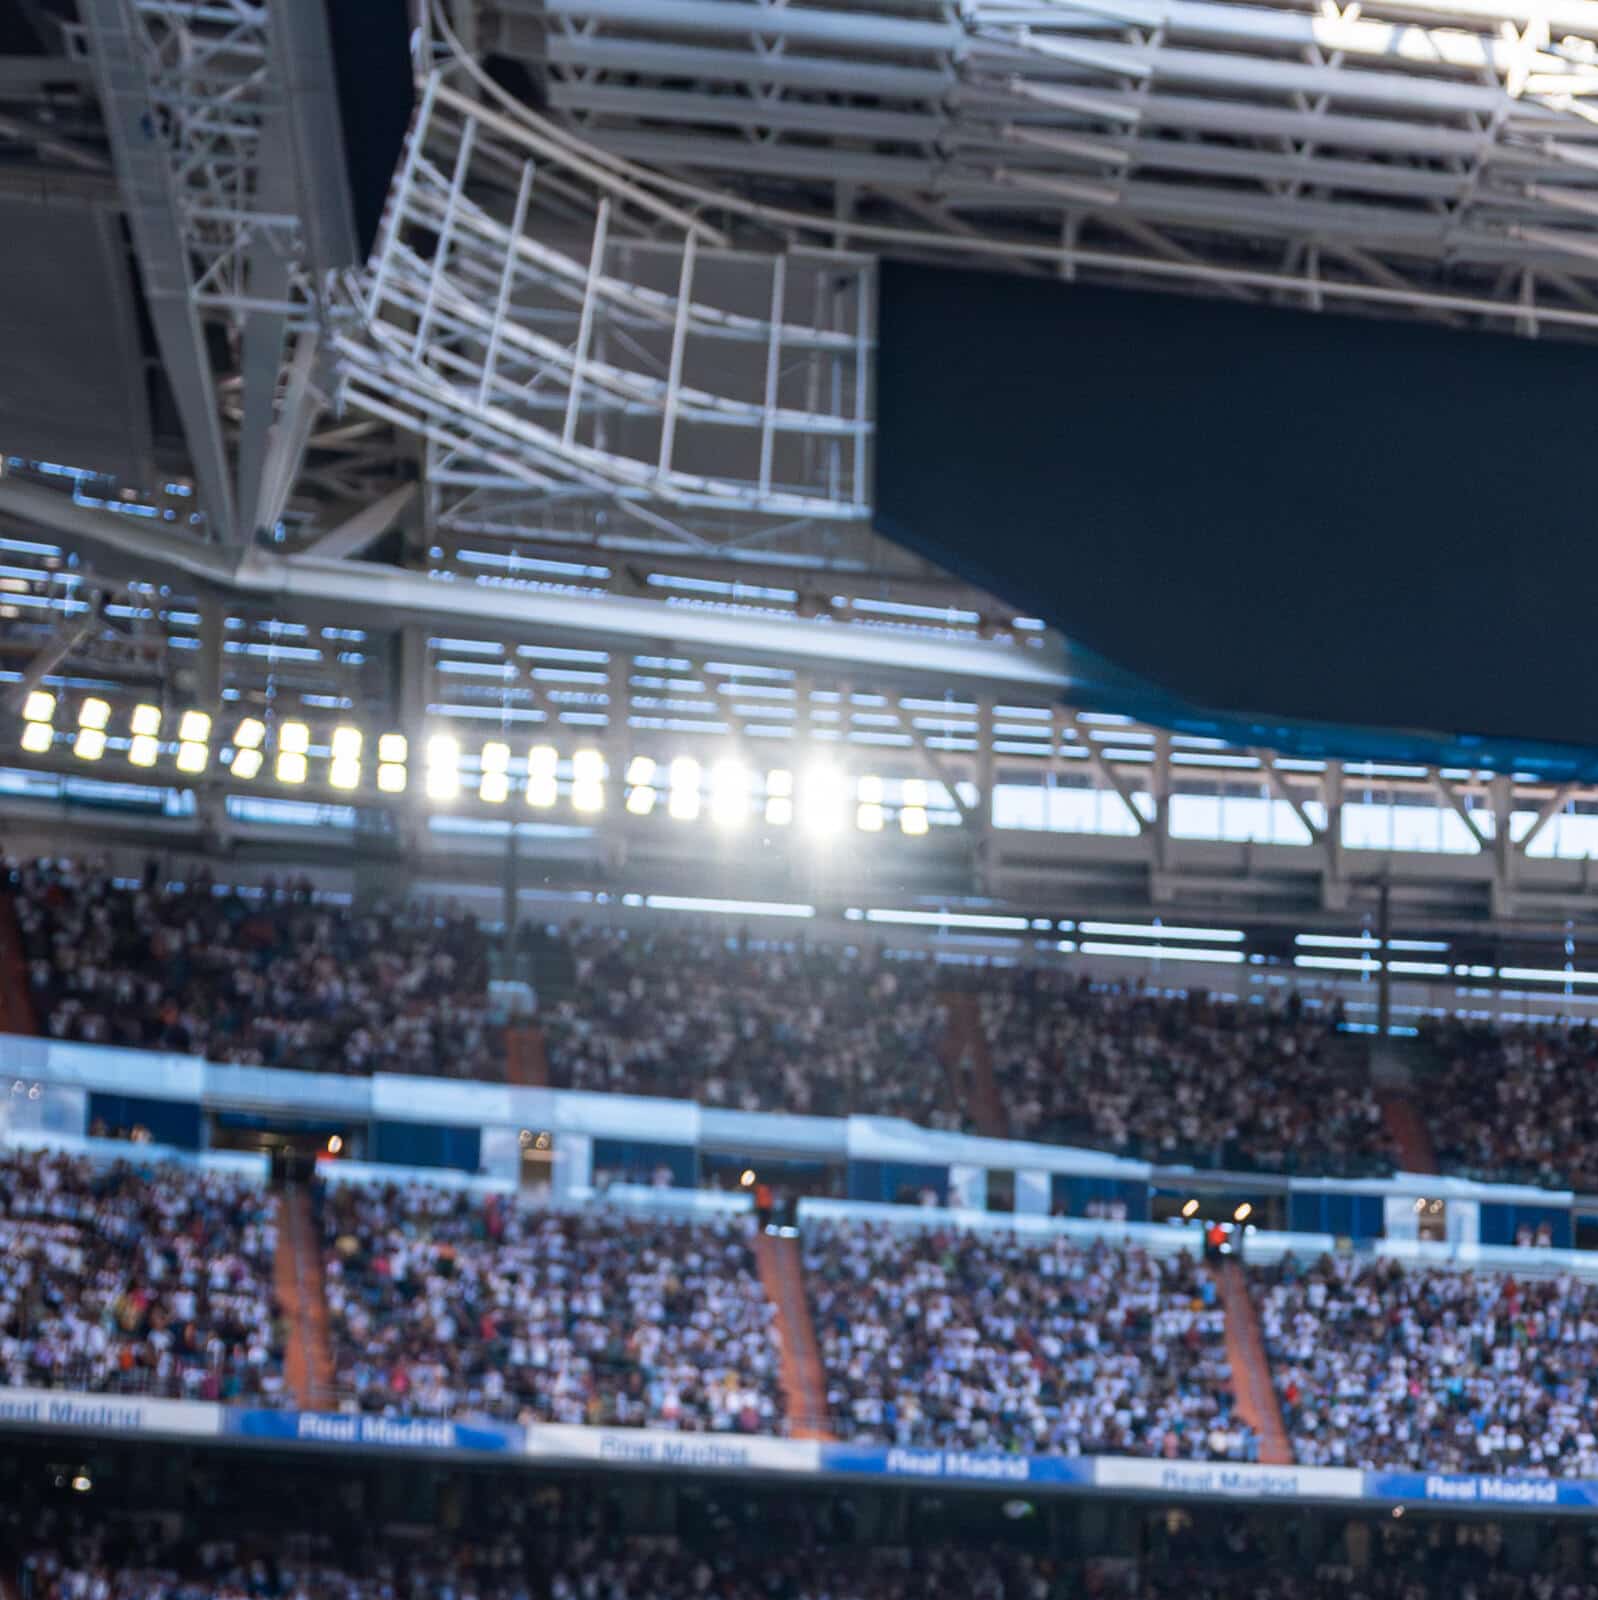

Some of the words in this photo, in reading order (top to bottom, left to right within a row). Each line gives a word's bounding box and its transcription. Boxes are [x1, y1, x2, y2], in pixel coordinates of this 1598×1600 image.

[361, 1415, 453, 1447] Madrid
[1426, 1474, 1476, 1499] Real
[1481, 1476, 1557, 1502] Madrid
